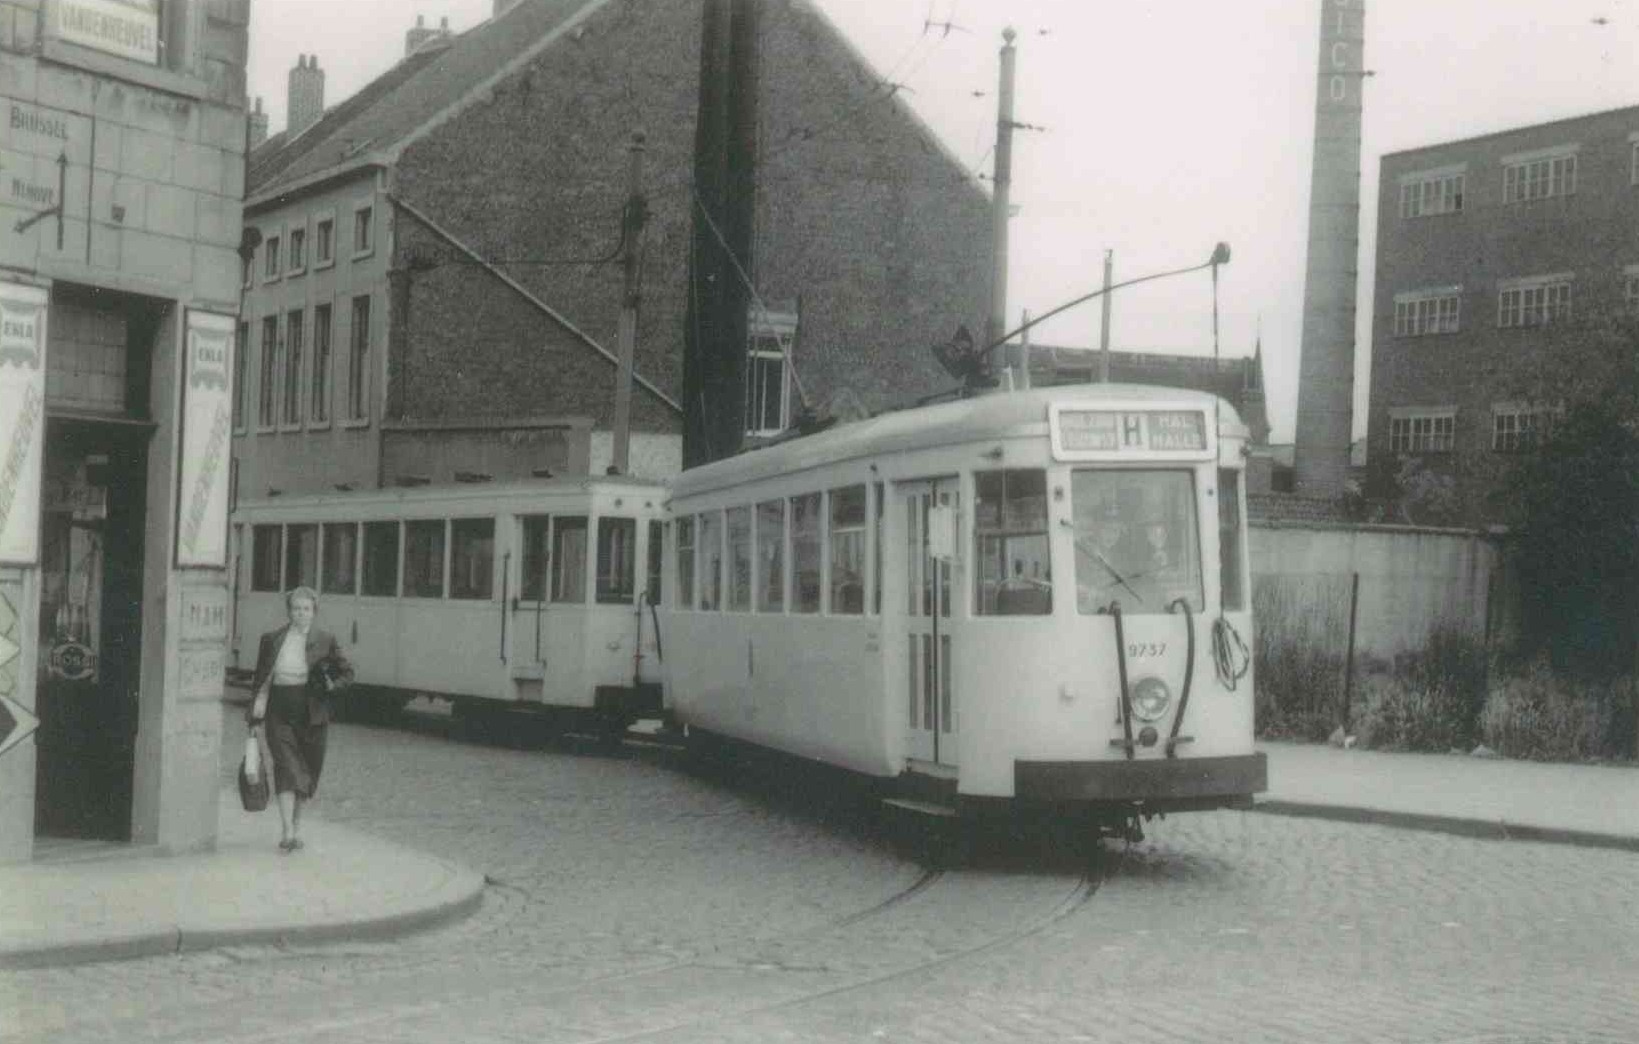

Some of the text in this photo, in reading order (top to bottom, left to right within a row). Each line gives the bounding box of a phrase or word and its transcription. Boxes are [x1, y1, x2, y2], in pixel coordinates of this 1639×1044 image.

[10, 106, 68, 141] BRUSSEL
[1123, 414, 1142, 446] H
[1128, 642, 1167, 658] 9737
